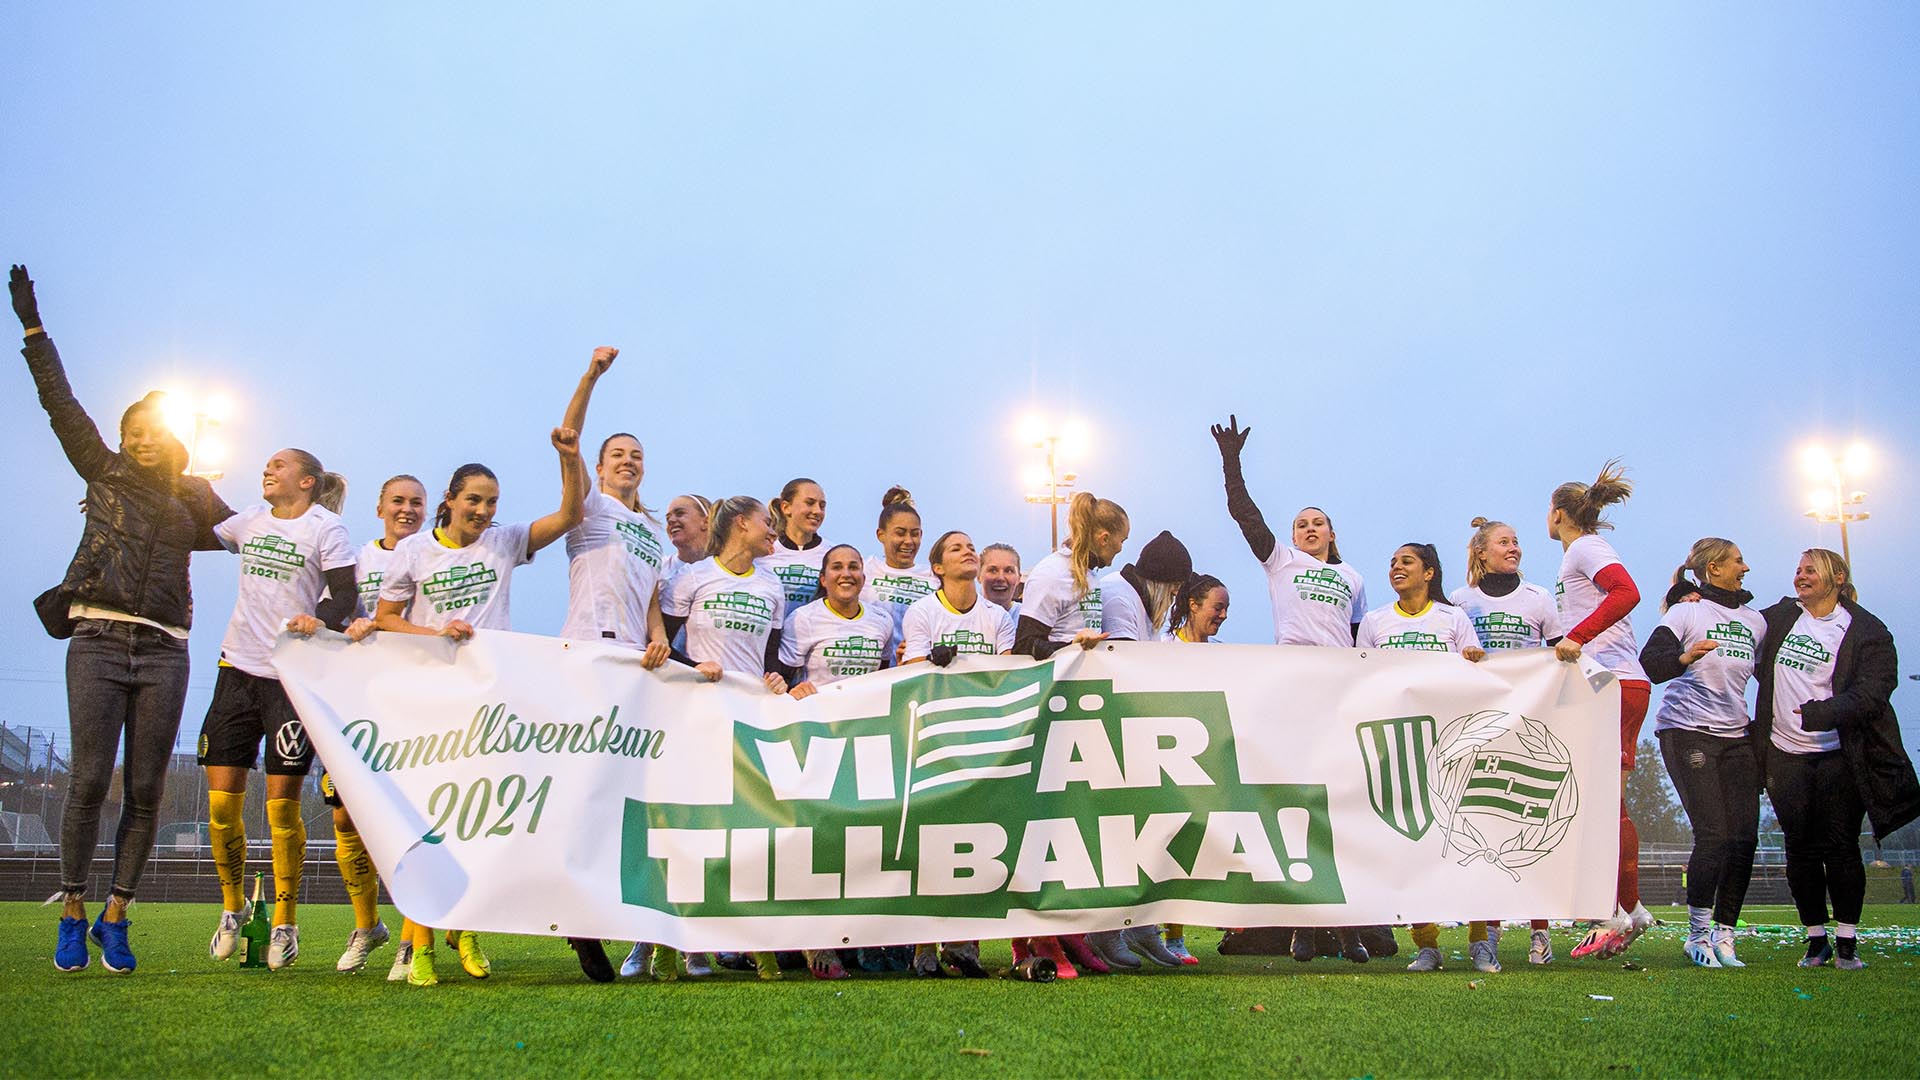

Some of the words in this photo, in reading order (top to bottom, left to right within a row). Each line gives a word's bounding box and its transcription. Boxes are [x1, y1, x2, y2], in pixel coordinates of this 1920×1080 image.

[634, 547, 658, 568] 2021
[250, 566, 279, 580] 2021
[445, 596, 478, 611] 2021
[888, 595, 917, 606] 202
[1310, 593, 1339, 606] 2021
[725, 620, 756, 633] 2021
[1474, 624, 1529, 635] ILLBAKA!
[1726, 650, 1750, 660] 2021
[1779, 656, 1805, 671] 2021
[841, 667, 869, 676] 2021
[341, 702, 666, 774] Damallsvenskan
[754, 734, 897, 801] VI
[1035, 693, 1217, 794] ÄR
[421, 773, 553, 846] 2021
[647, 805, 1311, 904] TILLBAKA!
